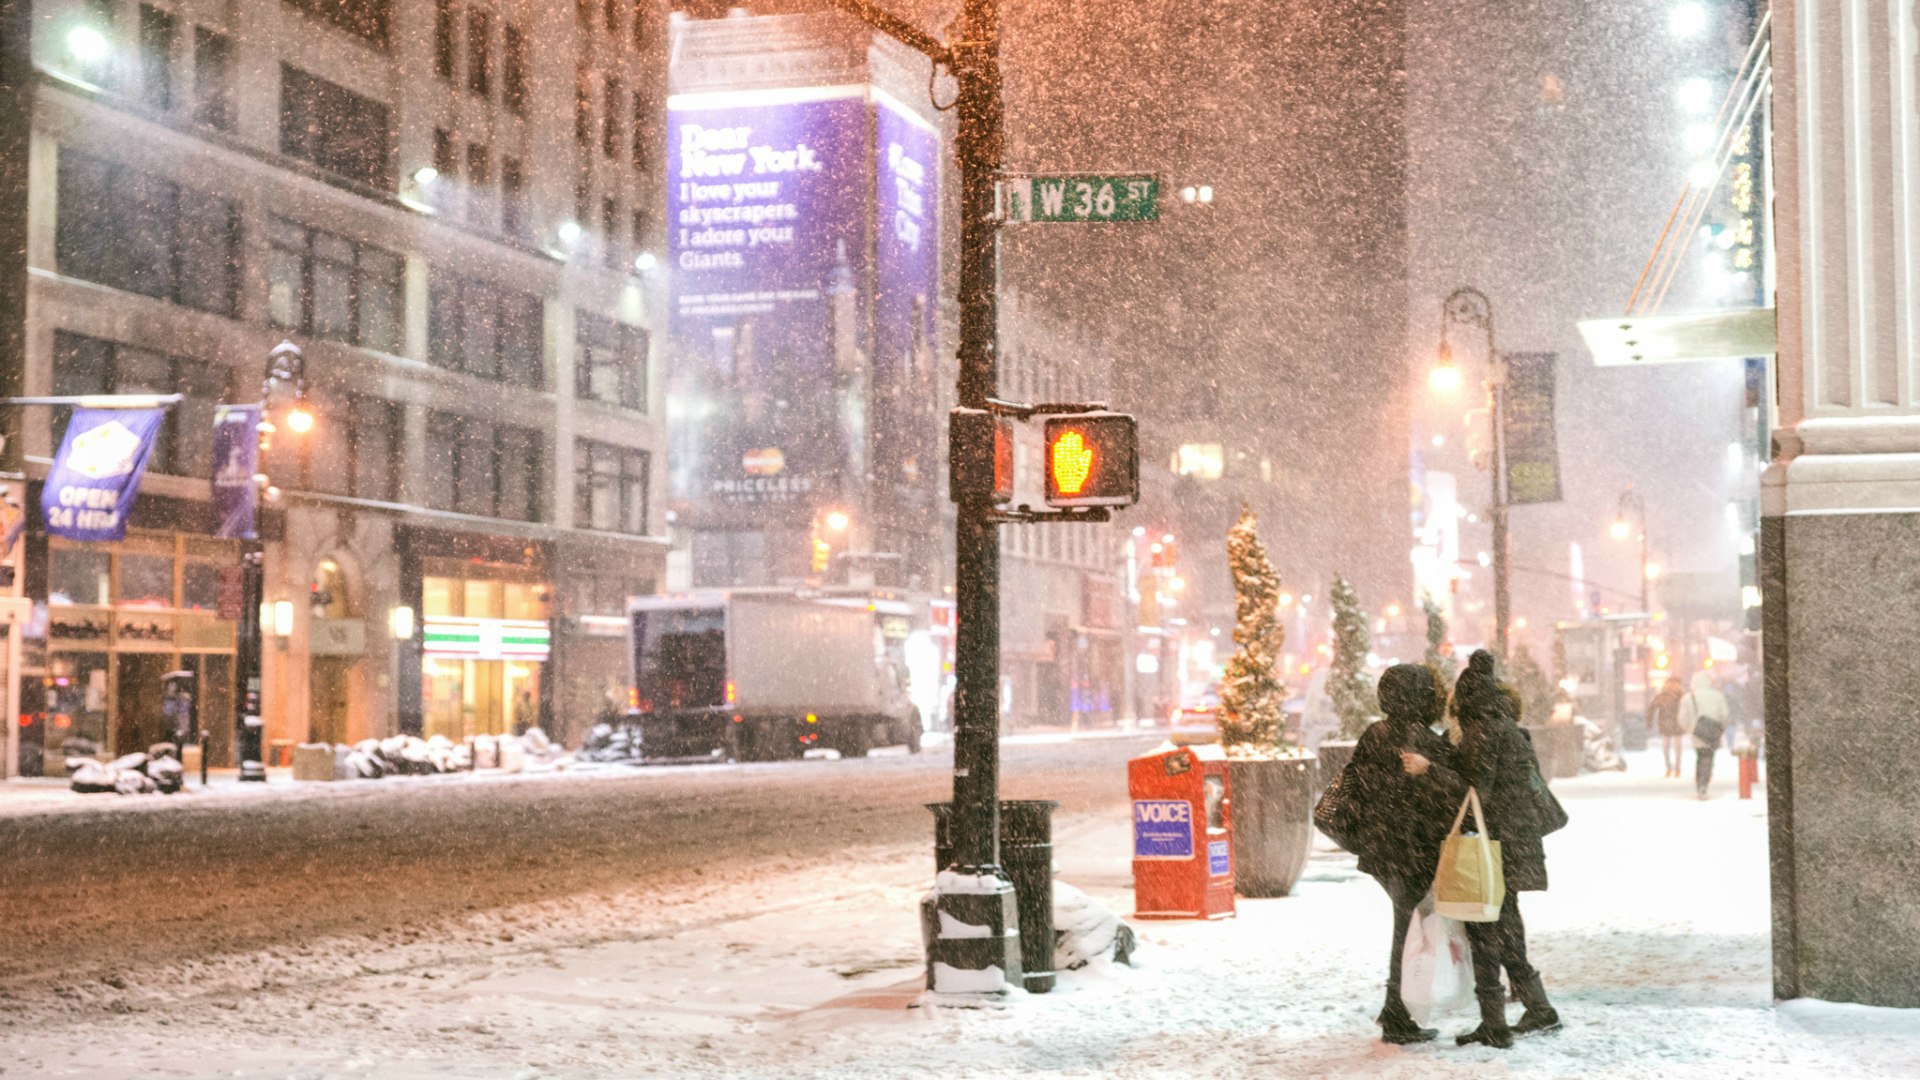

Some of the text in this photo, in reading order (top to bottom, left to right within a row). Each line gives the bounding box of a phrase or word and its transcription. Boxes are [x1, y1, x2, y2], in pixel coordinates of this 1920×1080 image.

[680, 124, 750, 150] Dear
[680, 144, 822, 178] New York.
[680, 181, 779, 205] I love your
[1041, 181, 1151, 217] W 36 ST
[679, 204, 799, 226] skyscrapers.
[680, 226, 794, 248] I adore your
[59, 485, 119, 509] OPEN
[48, 506, 73, 529] 24
[1136, 803, 1190, 822] VOICE
